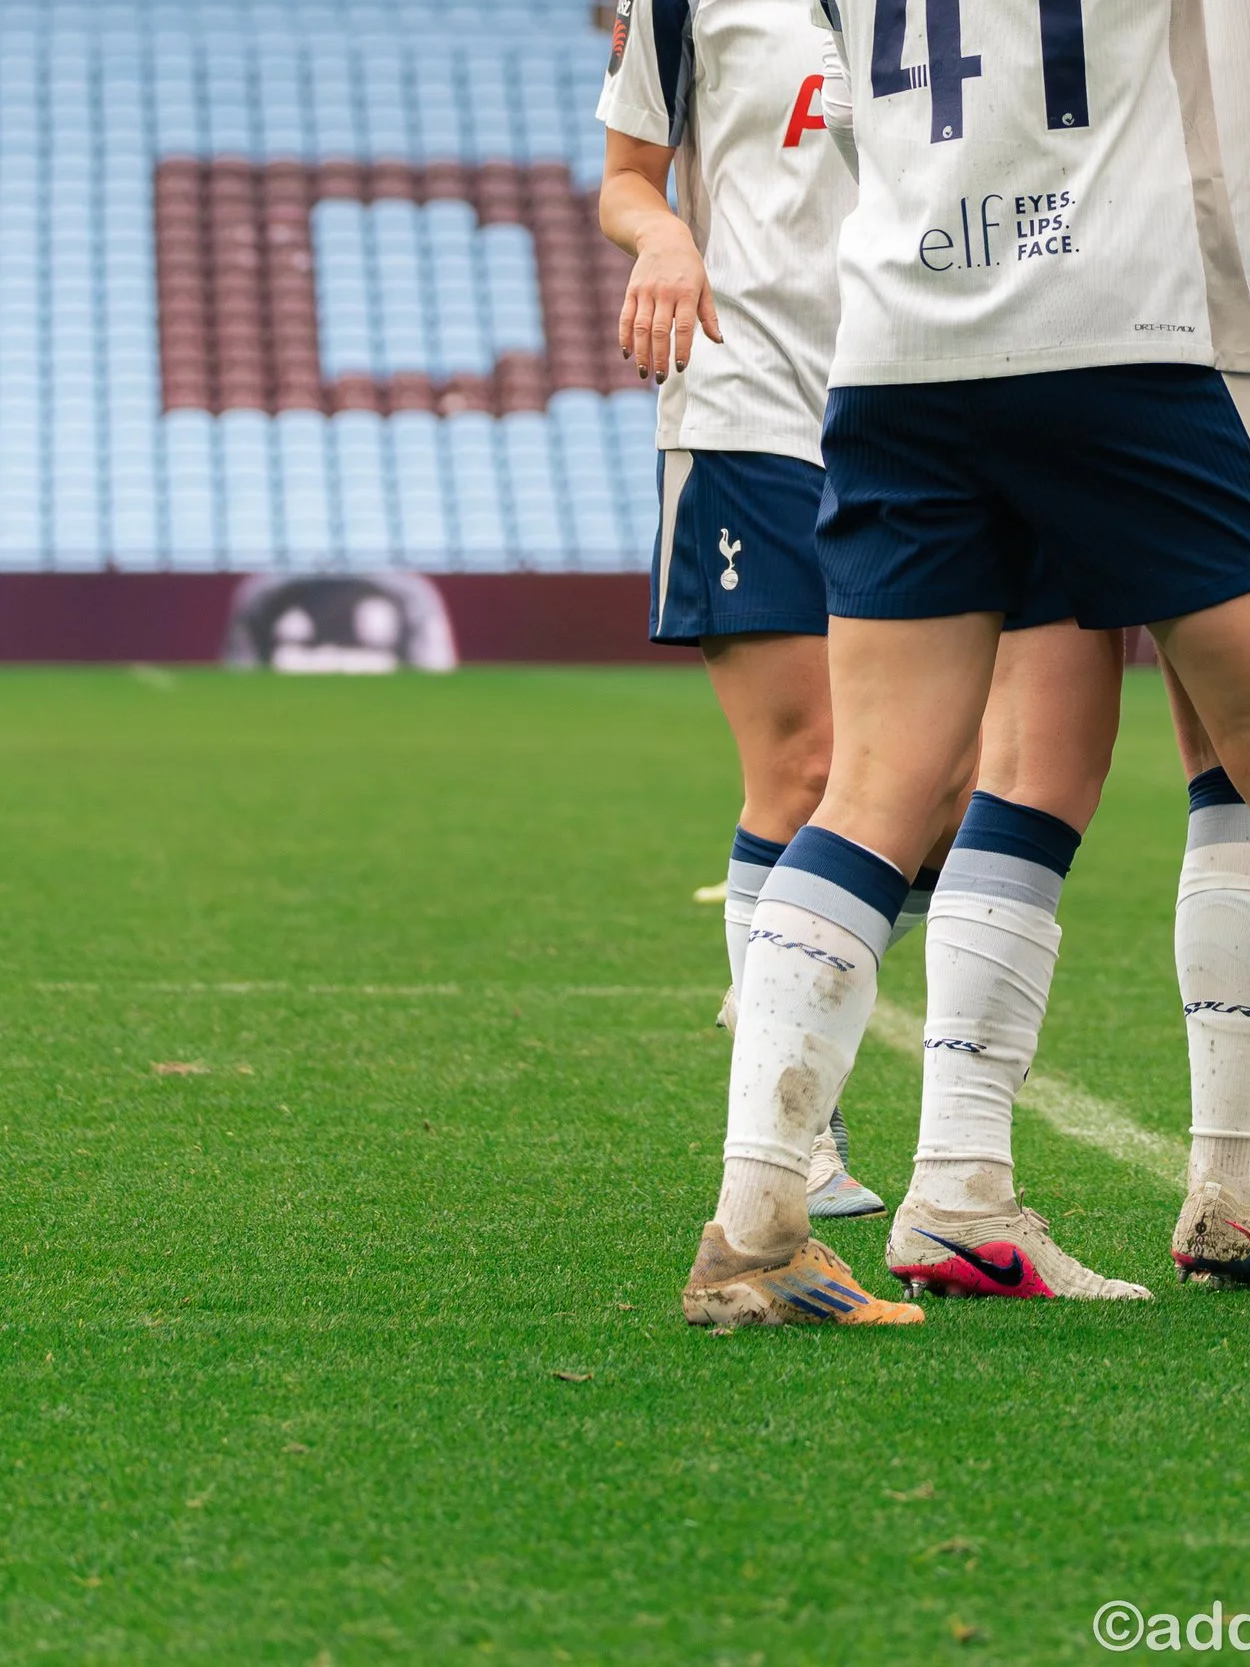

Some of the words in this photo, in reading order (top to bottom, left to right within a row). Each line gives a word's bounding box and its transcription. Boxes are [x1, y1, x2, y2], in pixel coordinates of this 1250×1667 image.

[1015, 191, 1076, 214] EYES.
[1017, 214, 1070, 239] LIPS.
[1017, 235, 1079, 261] FACE.
